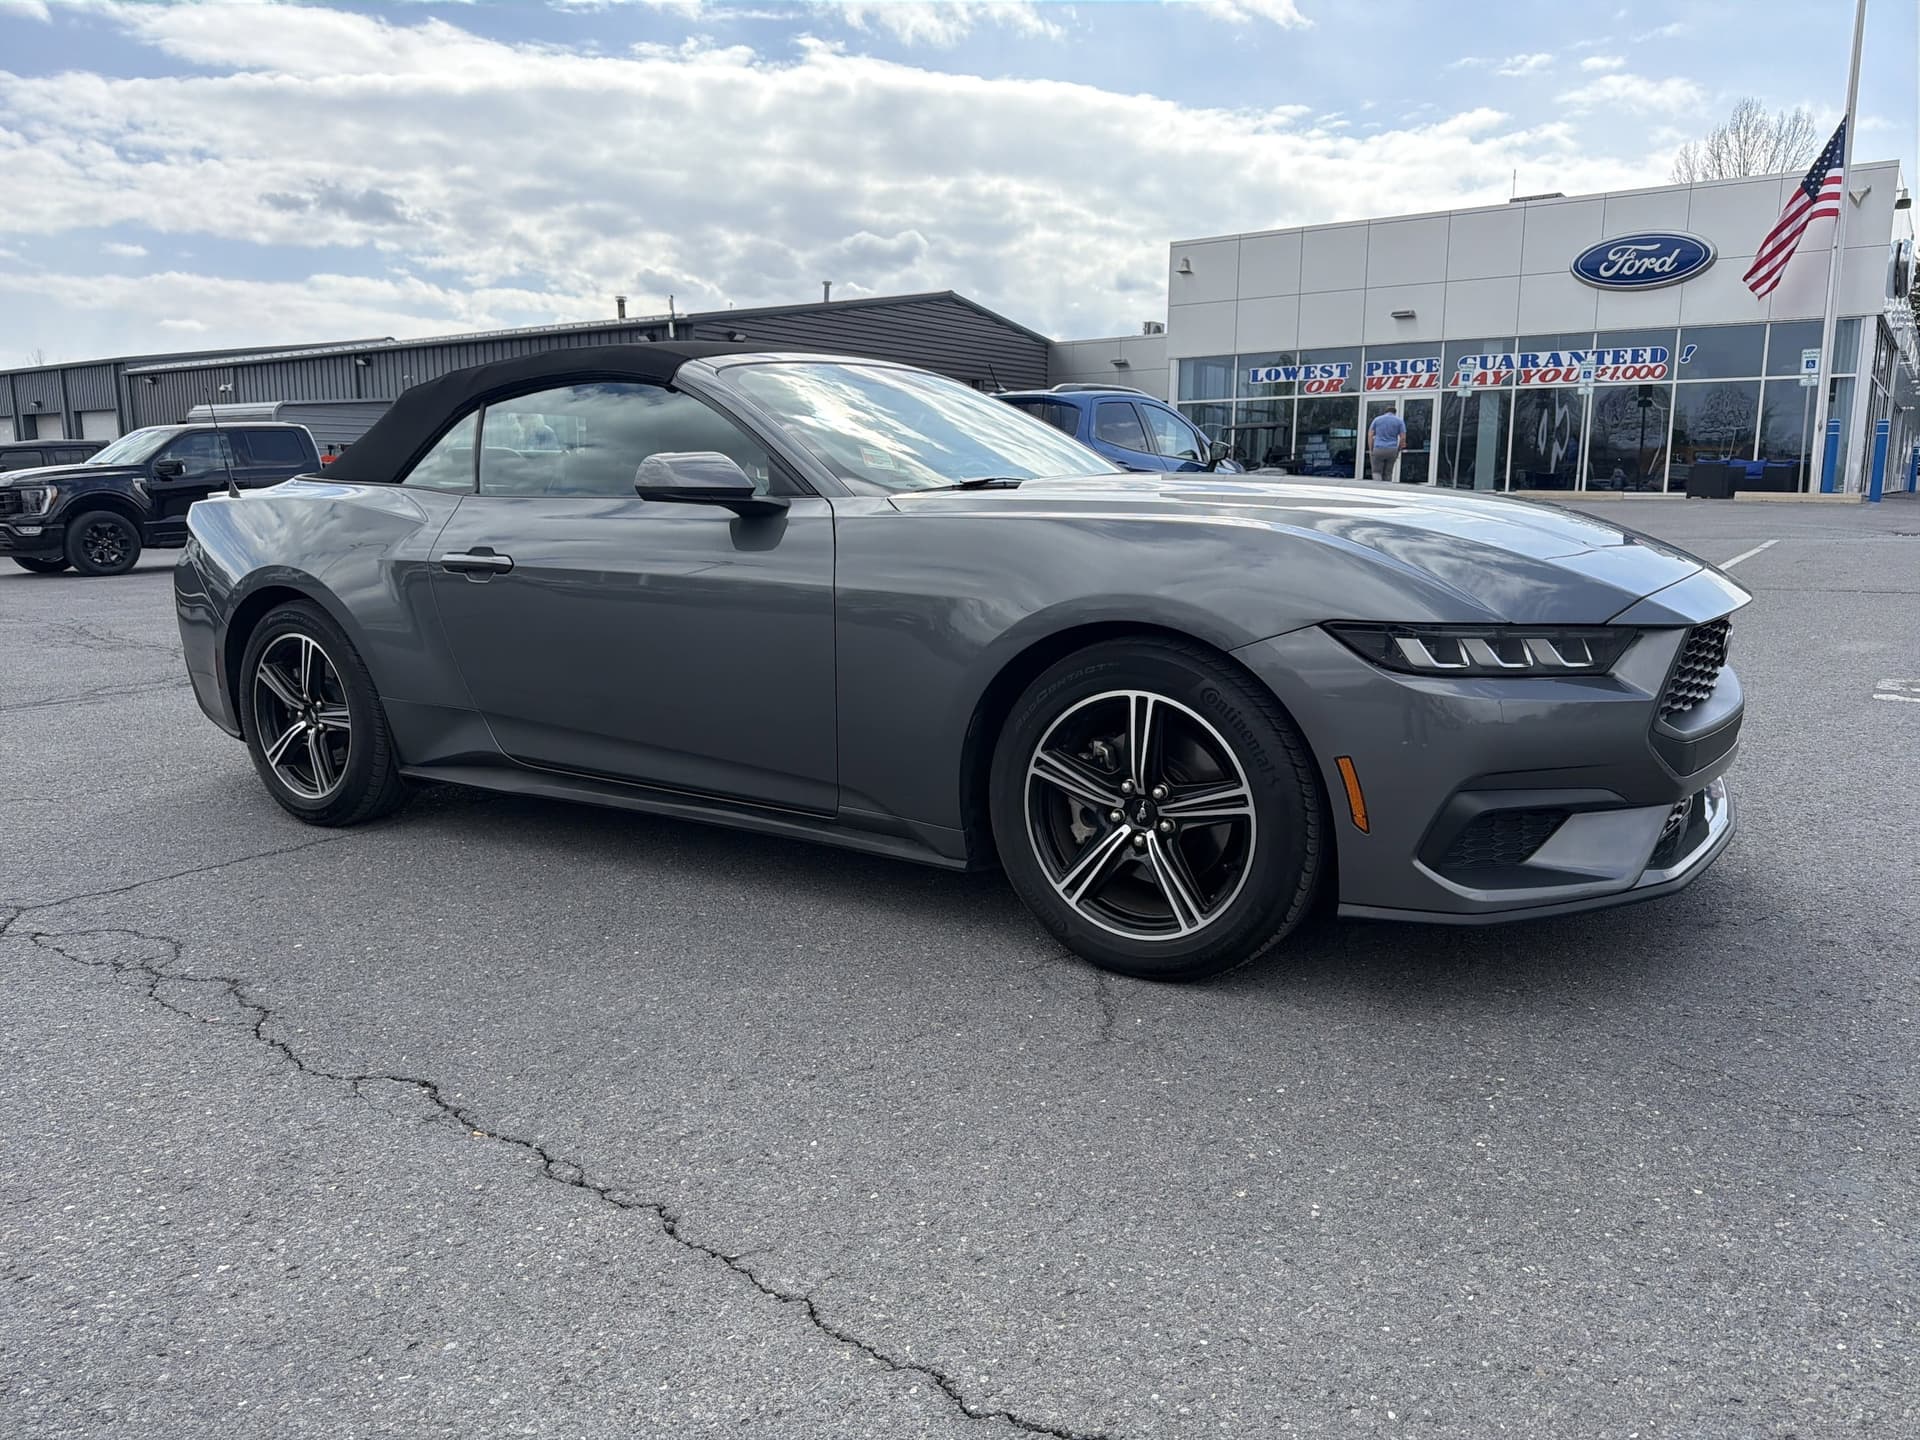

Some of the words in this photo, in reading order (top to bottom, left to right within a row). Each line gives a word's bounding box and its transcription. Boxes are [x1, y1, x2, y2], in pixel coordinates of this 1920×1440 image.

[1599, 243, 1681, 278] Ford
[1251, 363, 1351, 383] LOWEST
[1366, 359, 1440, 376] PRICE
[1305, 379, 1345, 393] OR
[1521, 368, 1580, 384] YOU
[1200, 687, 1275, 772] Continental
